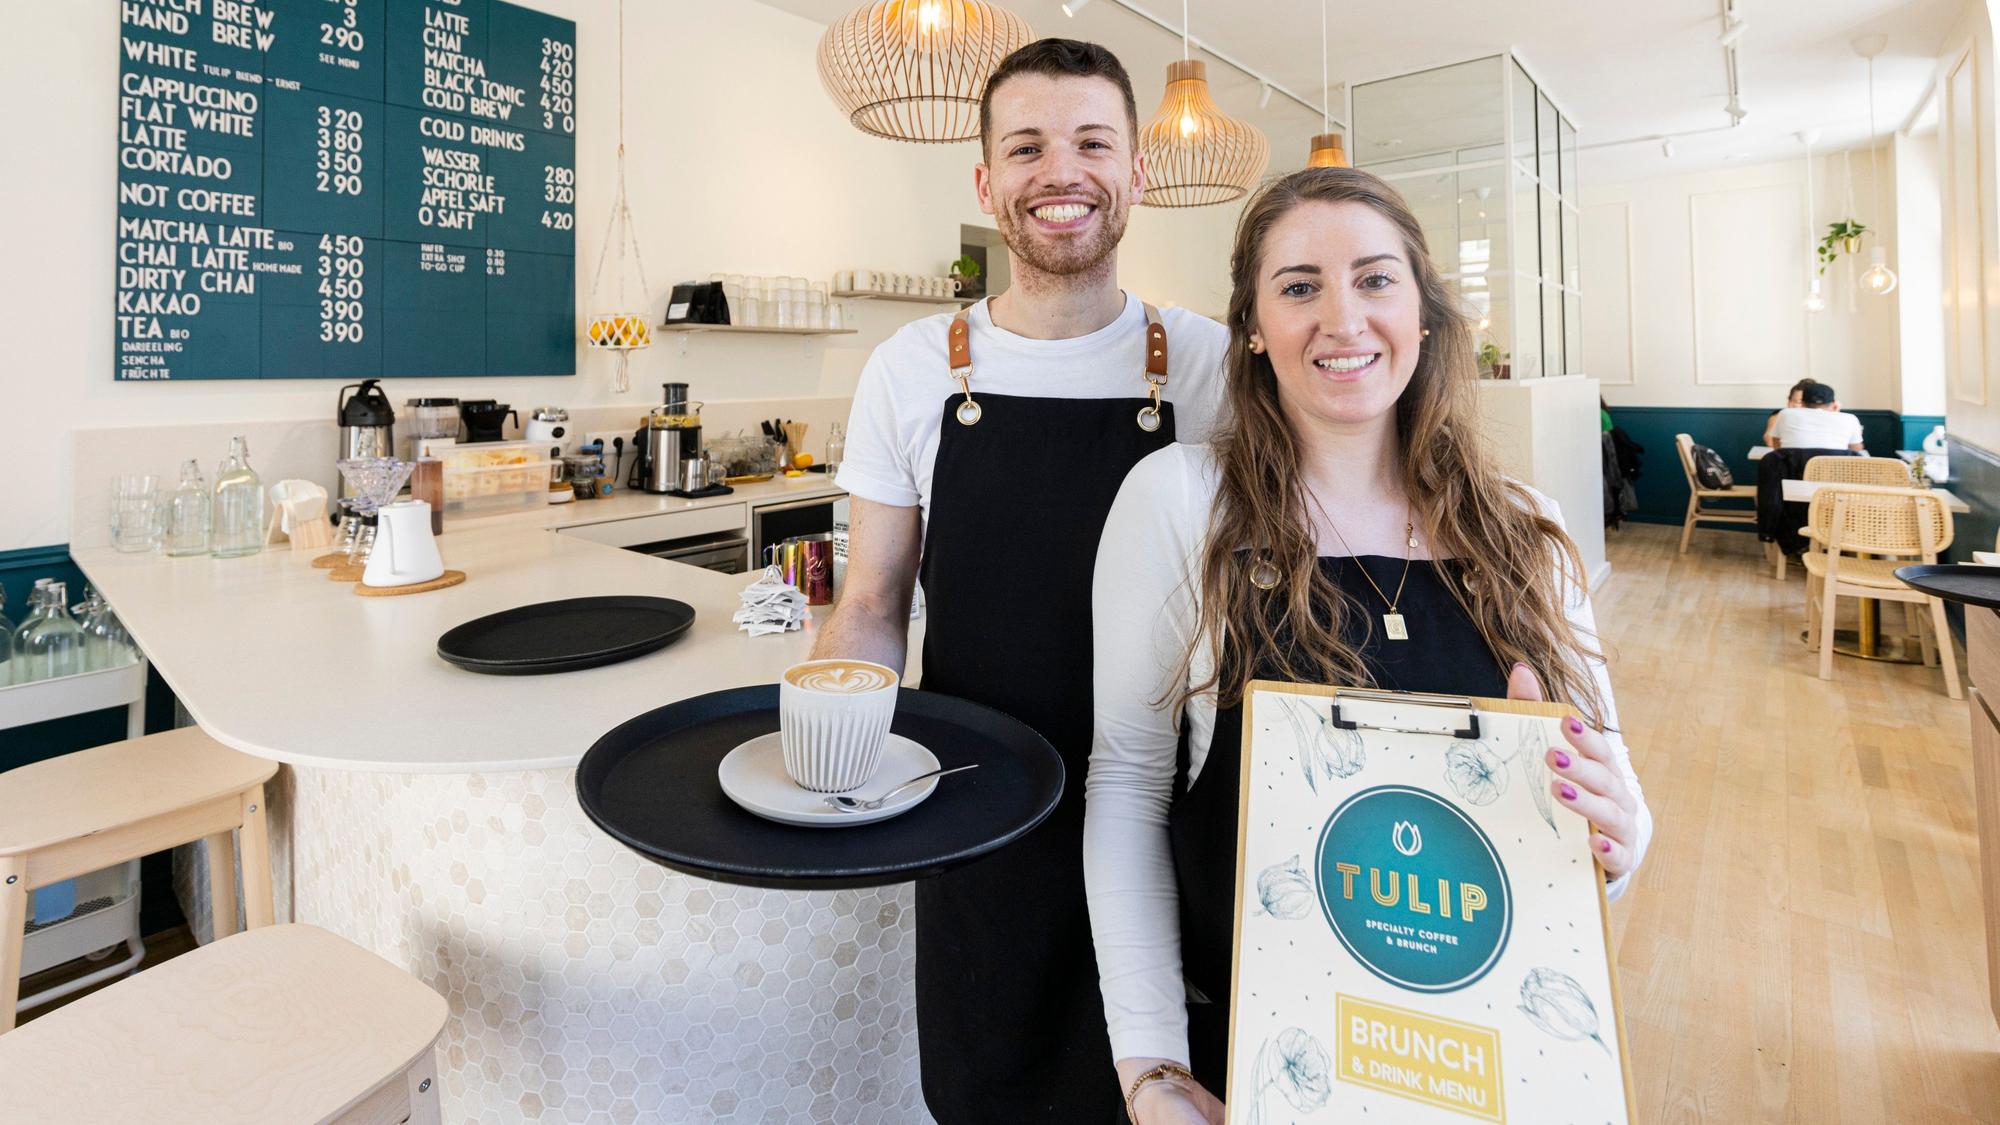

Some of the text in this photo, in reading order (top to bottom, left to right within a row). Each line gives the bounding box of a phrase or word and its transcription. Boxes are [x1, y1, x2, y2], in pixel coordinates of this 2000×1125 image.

[122, 2, 188, 35] HAND
[213, 22, 275, 52] BREW
[213, 0, 275, 29] BREW
[424, 6, 469, 35] LATTE
[320, 24, 364, 51] 290
[423, 28, 461, 52] CHAI
[542, 38, 573, 61] 390
[123, 37, 197, 71] WHITE
[203, 64, 231, 78] TULIP
[319, 53, 359, 69] SEE MENU
[424, 48, 485, 78] MATCHA
[540, 57, 573, 78] 420
[123, 73, 258, 114] CAPPUCCINO
[424, 68, 526, 107] BLACK TONIC
[540, 76, 573, 96] 450
[422, 88, 512, 120] COLD BREW
[540, 95, 573, 114] 420
[122, 97, 254, 137] FLAT WHITE
[122, 121, 187, 151] LATTE
[420, 117, 525, 151] COLD DRINKS
[121, 147, 232, 180] CORTADO
[422, 146, 480, 172] WASSER
[423, 167, 494, 193] SCHORLE
[545, 166, 574, 186] 280
[121, 182, 256, 216] NOT COFFEE
[421, 188, 505, 214] APFEL SAFT
[545, 186, 574, 204] 320
[438, 210, 475, 230] SAFT
[541, 211, 573, 230] 420
[120, 216, 294, 252] MATCHA LATTE BIO
[319, 234, 363, 256] 450
[120, 243, 176, 266] CHAI
[192, 248, 249, 271] LATTE
[318, 256, 363, 278] 390
[420, 262, 465, 272] TO-GO CUP
[422, 253, 465, 263] EXTRA SHOT
[120, 267, 254, 294] DIRTY CHAI
[318, 278, 363, 299] 450
[118, 292, 200, 315] KAKAO
[320, 300, 363, 321] 390
[118, 317, 190, 339] TEA BIO
[320, 322, 363, 343] 390
[122, 342, 183, 352] DARJEELING
[122, 355, 165, 365] SENCHA
[122, 367, 170, 379] FRÜCHTE
[1336, 862, 1488, 922] TULIP
[1366, 920, 1458, 945] SPECIALTY COFFEE
[1386, 936, 1437, 954] & BRUNCH
[1352, 1015, 1485, 1077] BRUNCH
[1352, 1056, 1486, 1108] & DRINK MENU
